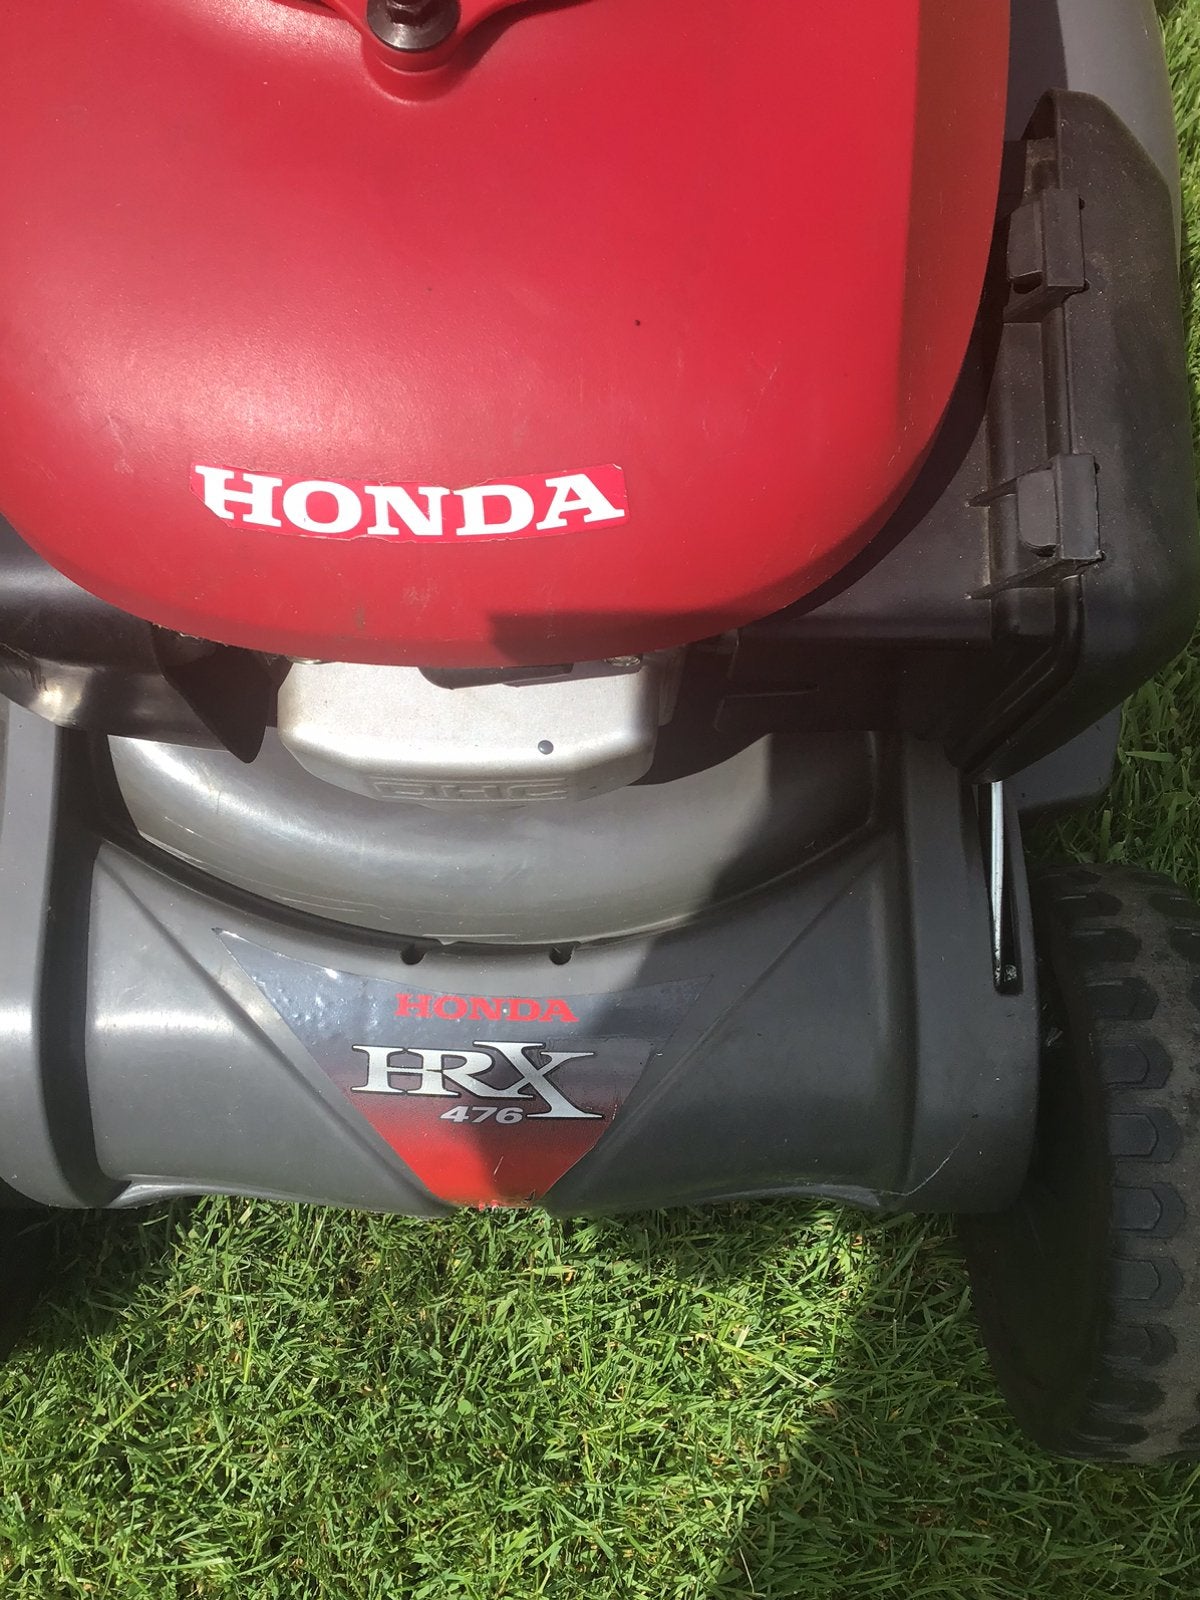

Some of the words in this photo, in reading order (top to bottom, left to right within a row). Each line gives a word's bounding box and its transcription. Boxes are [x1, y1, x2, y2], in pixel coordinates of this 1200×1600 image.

[195, 465, 625, 536] HONDA
[395, 993, 579, 1022] HONDA
[350, 1040, 603, 1119] HRX
[440, 1106, 524, 1124] 476
